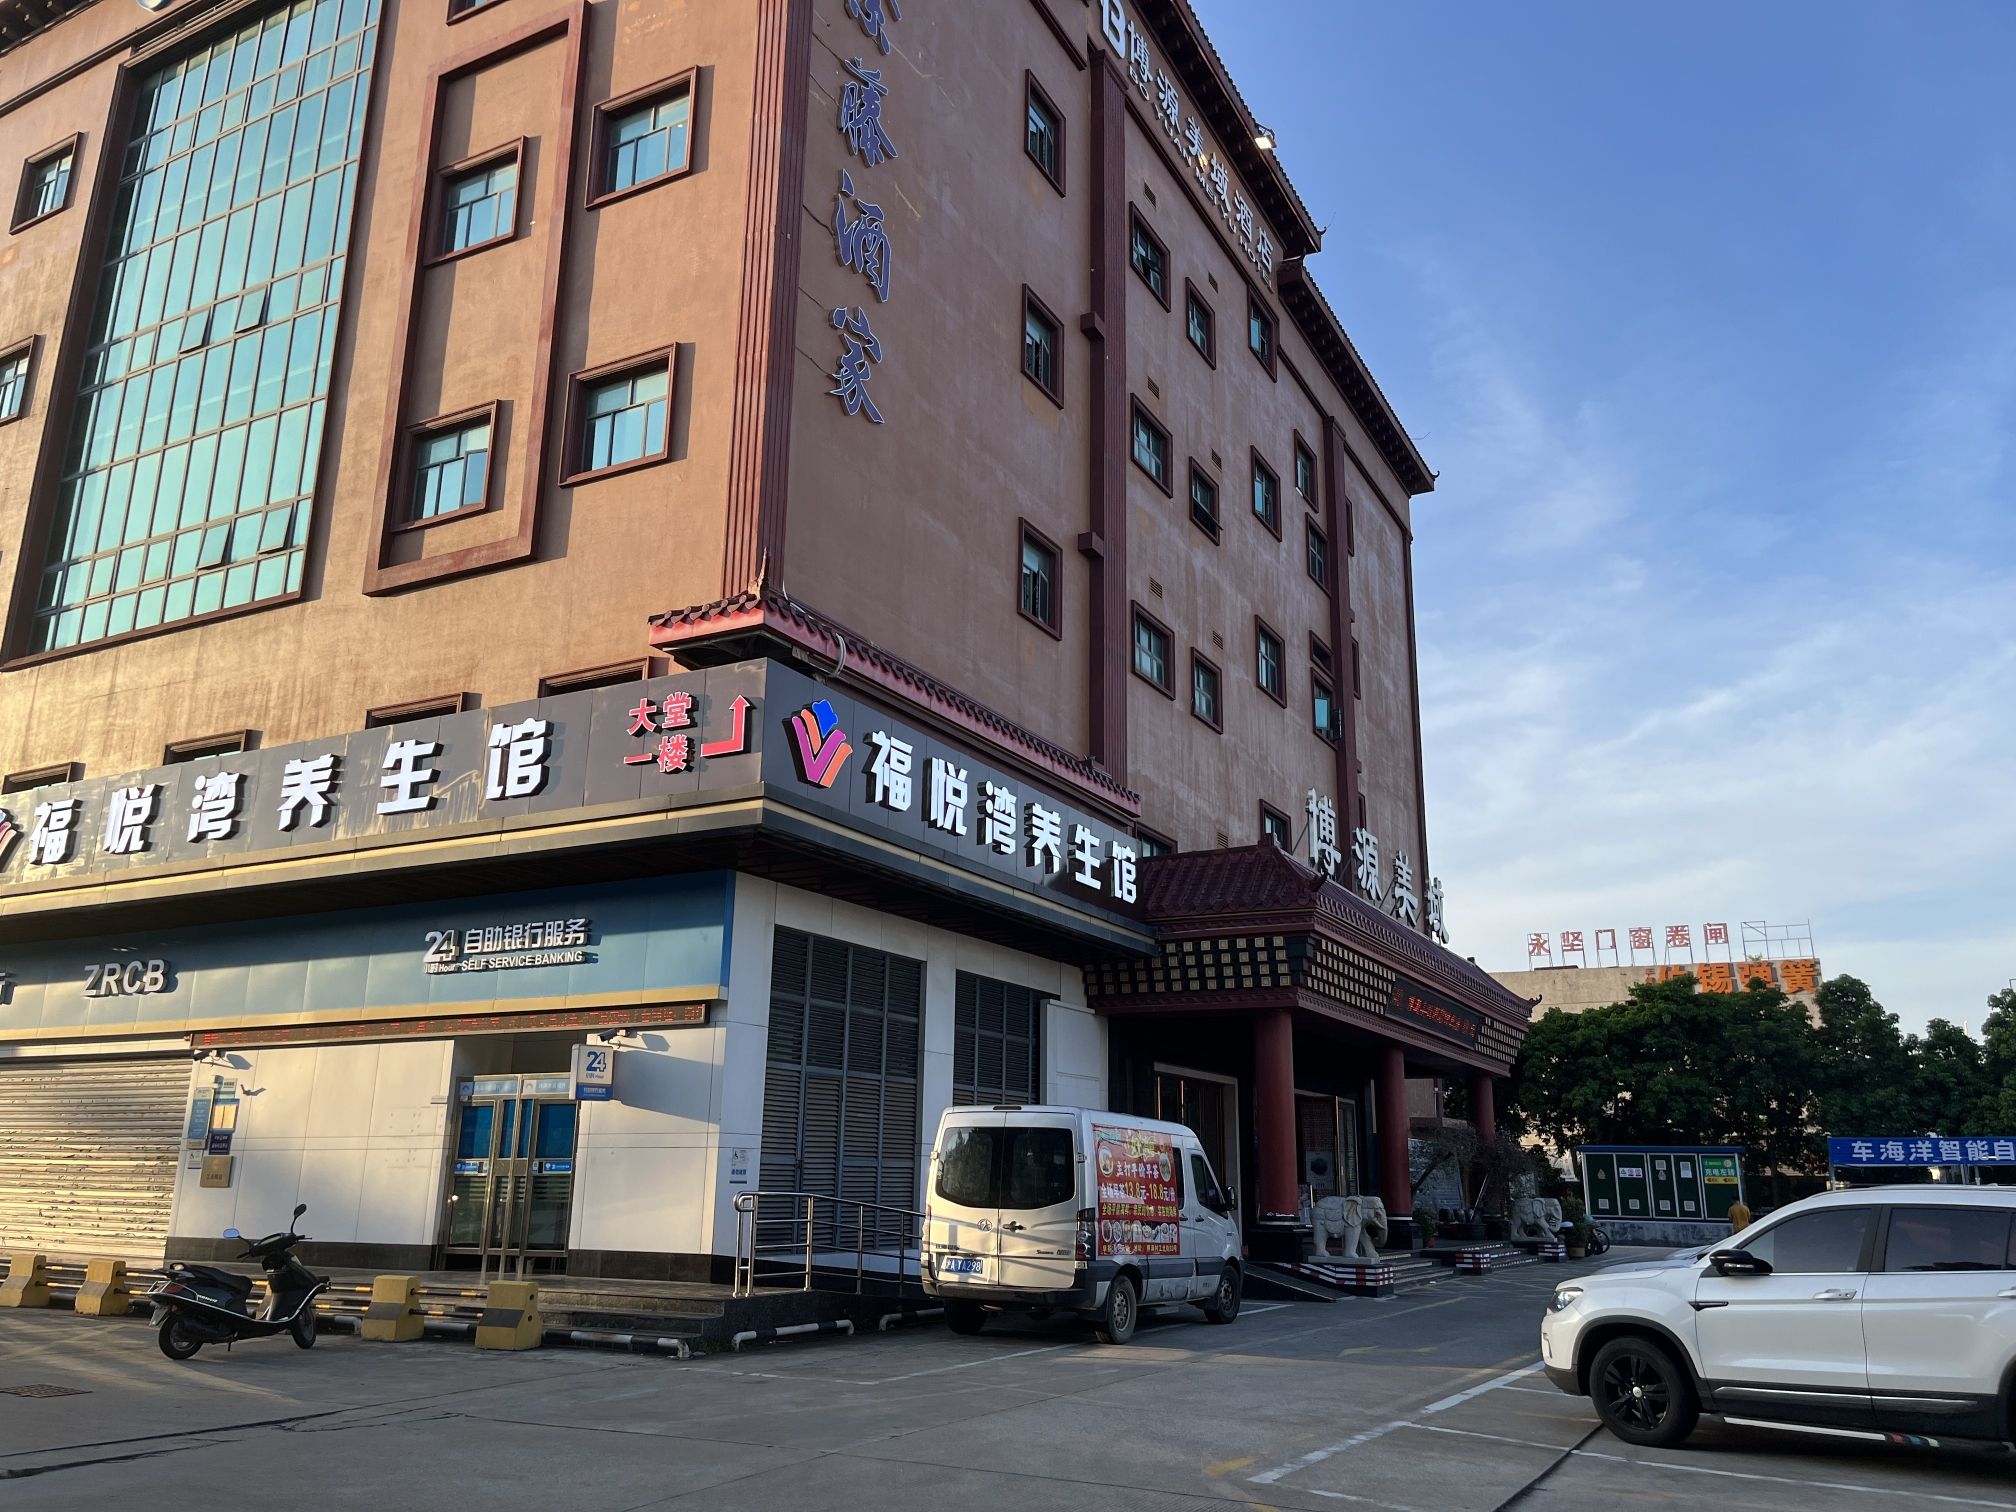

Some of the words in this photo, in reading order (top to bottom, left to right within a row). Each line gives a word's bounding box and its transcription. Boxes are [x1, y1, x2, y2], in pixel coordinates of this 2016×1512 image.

[1129, 65, 1150, 101] BO
[1128, 20, 1274, 274] 博源美域酒店
[626, 691, 692, 735] 大堂
[624, 734, 689, 773] 一楼
[29, 717, 552, 866] 福悦湾养生馆
[868, 730, 1137, 904] 福悦湾养生馆
[1305, 787, 1450, 944] 博源美域
[423, 929, 459, 963] 24
[464, 918, 587, 954] 自助银行服务
[1528, 922, 1729, 957] 永坚门窗卷闸
[83, 959, 166, 997] ZRCB
[461, 958, 487, 972] SELF
[488, 956, 533, 969] SERVICE
[535, 951, 583, 967] BANKING
[586, 1051, 606, 1072] 24
[1852, 1140, 2016, 1162] 车海洋智能自
